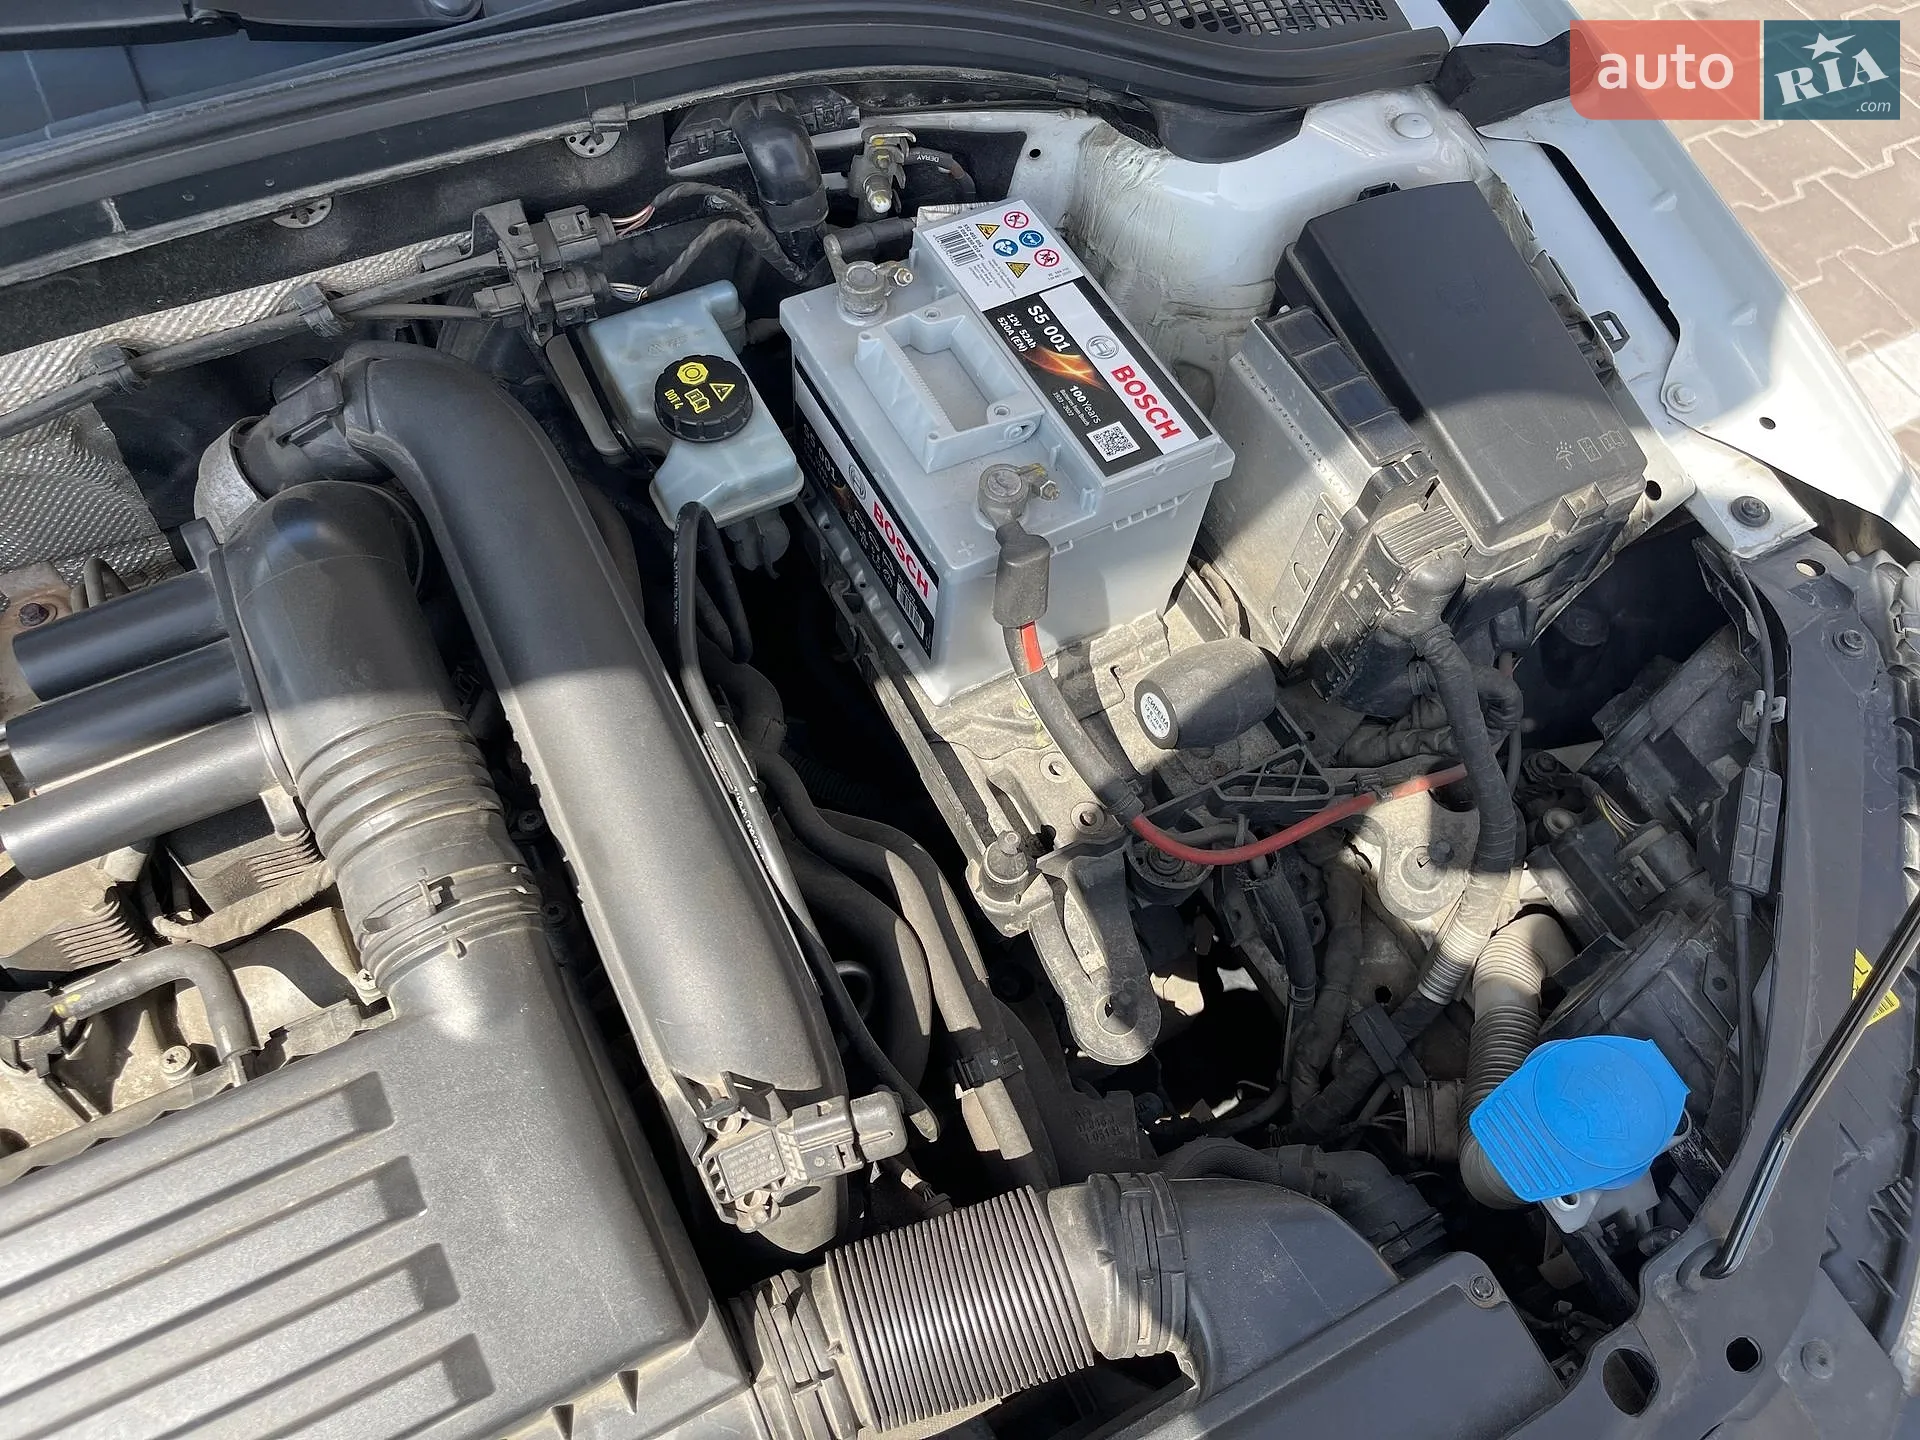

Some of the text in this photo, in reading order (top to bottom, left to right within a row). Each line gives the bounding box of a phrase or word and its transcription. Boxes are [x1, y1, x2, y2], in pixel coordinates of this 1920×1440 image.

[917, 154, 940, 163] DERAY
[997, 316, 1028, 352] 520A (EN)
[1006, 313, 1037, 349] 12V 52Ah
[1027, 305, 1071, 353] S5 001
[664, 389, 684, 410] DOT 4
[1069, 385, 1102, 425] 100 Years
[1111, 365, 1182, 440] BOSCH
[818, 447, 838, 481] 001
[873, 501, 928, 599] BOSCH
[1147, 696, 1169, 728] СИРЕНА
